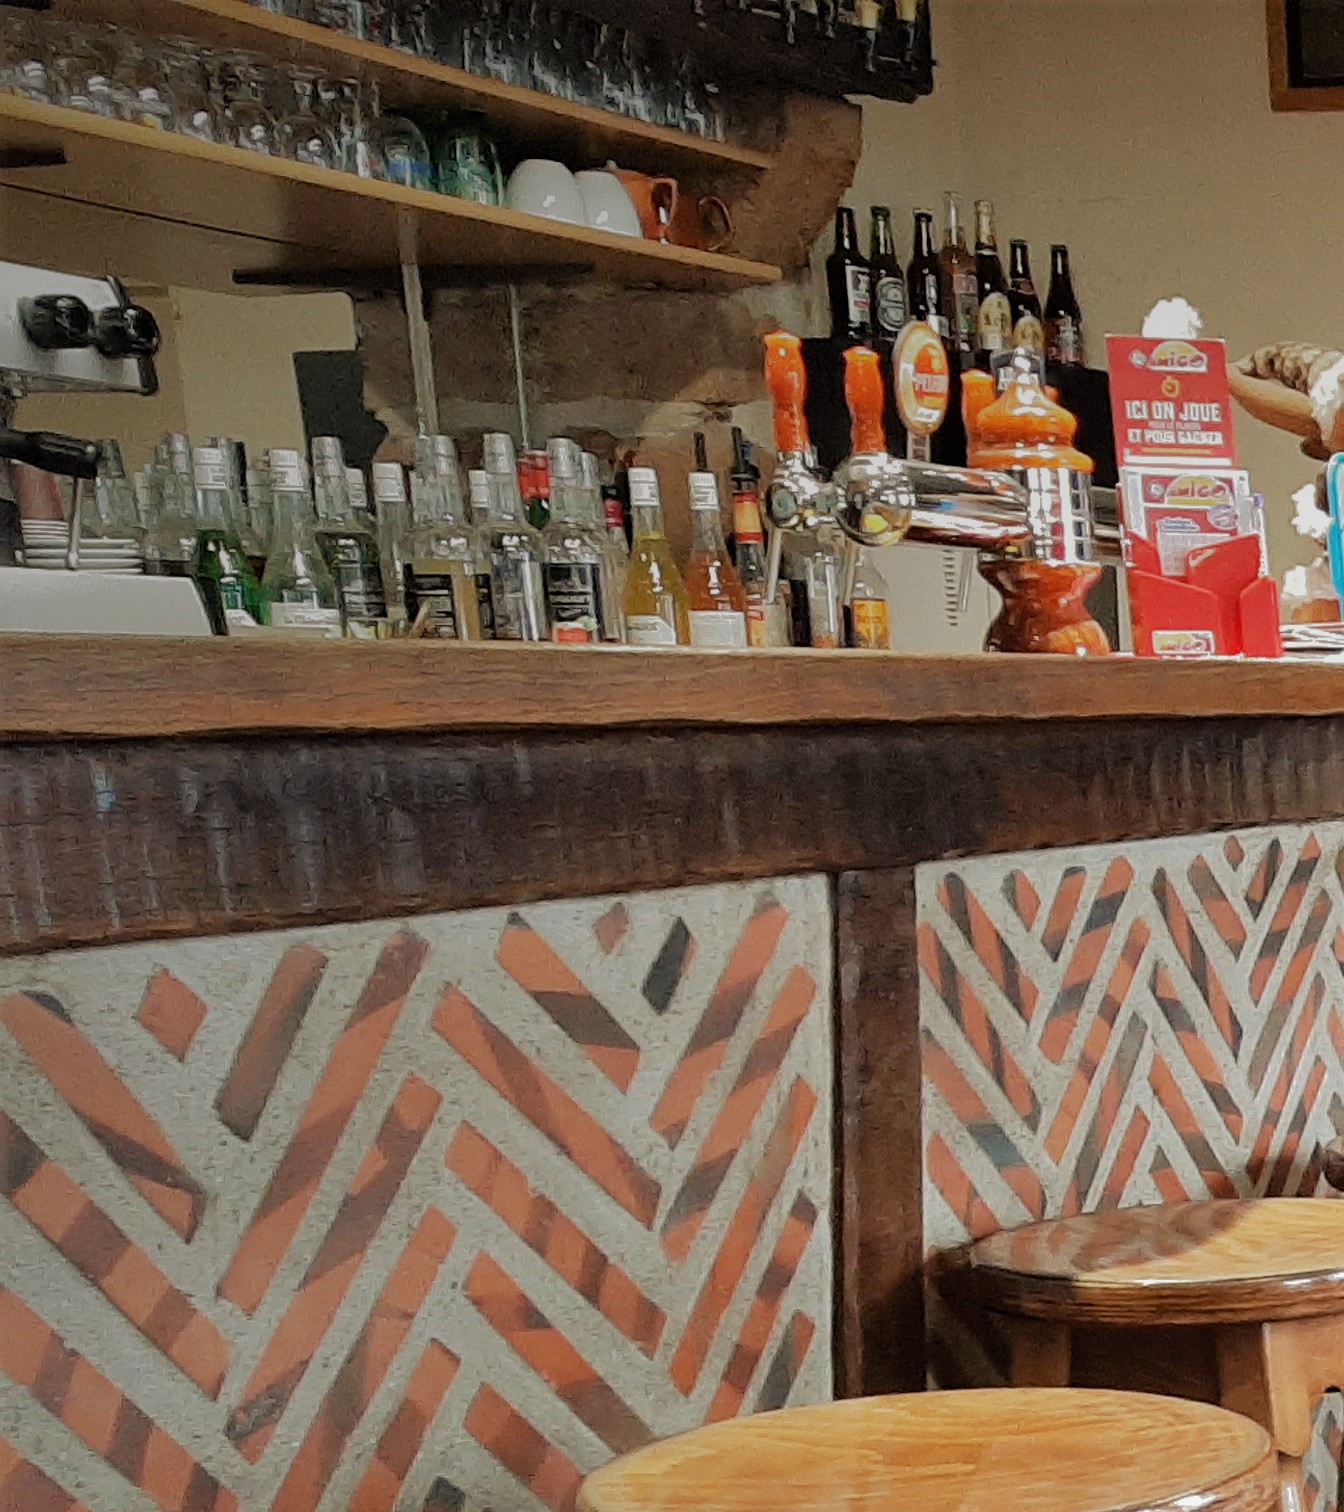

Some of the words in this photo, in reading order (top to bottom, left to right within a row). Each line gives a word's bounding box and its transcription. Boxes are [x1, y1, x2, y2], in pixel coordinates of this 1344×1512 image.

[1124, 400, 1148, 419] ICI
[1151, 401, 1175, 420] ON
[1179, 402, 1222, 422] JOUE
